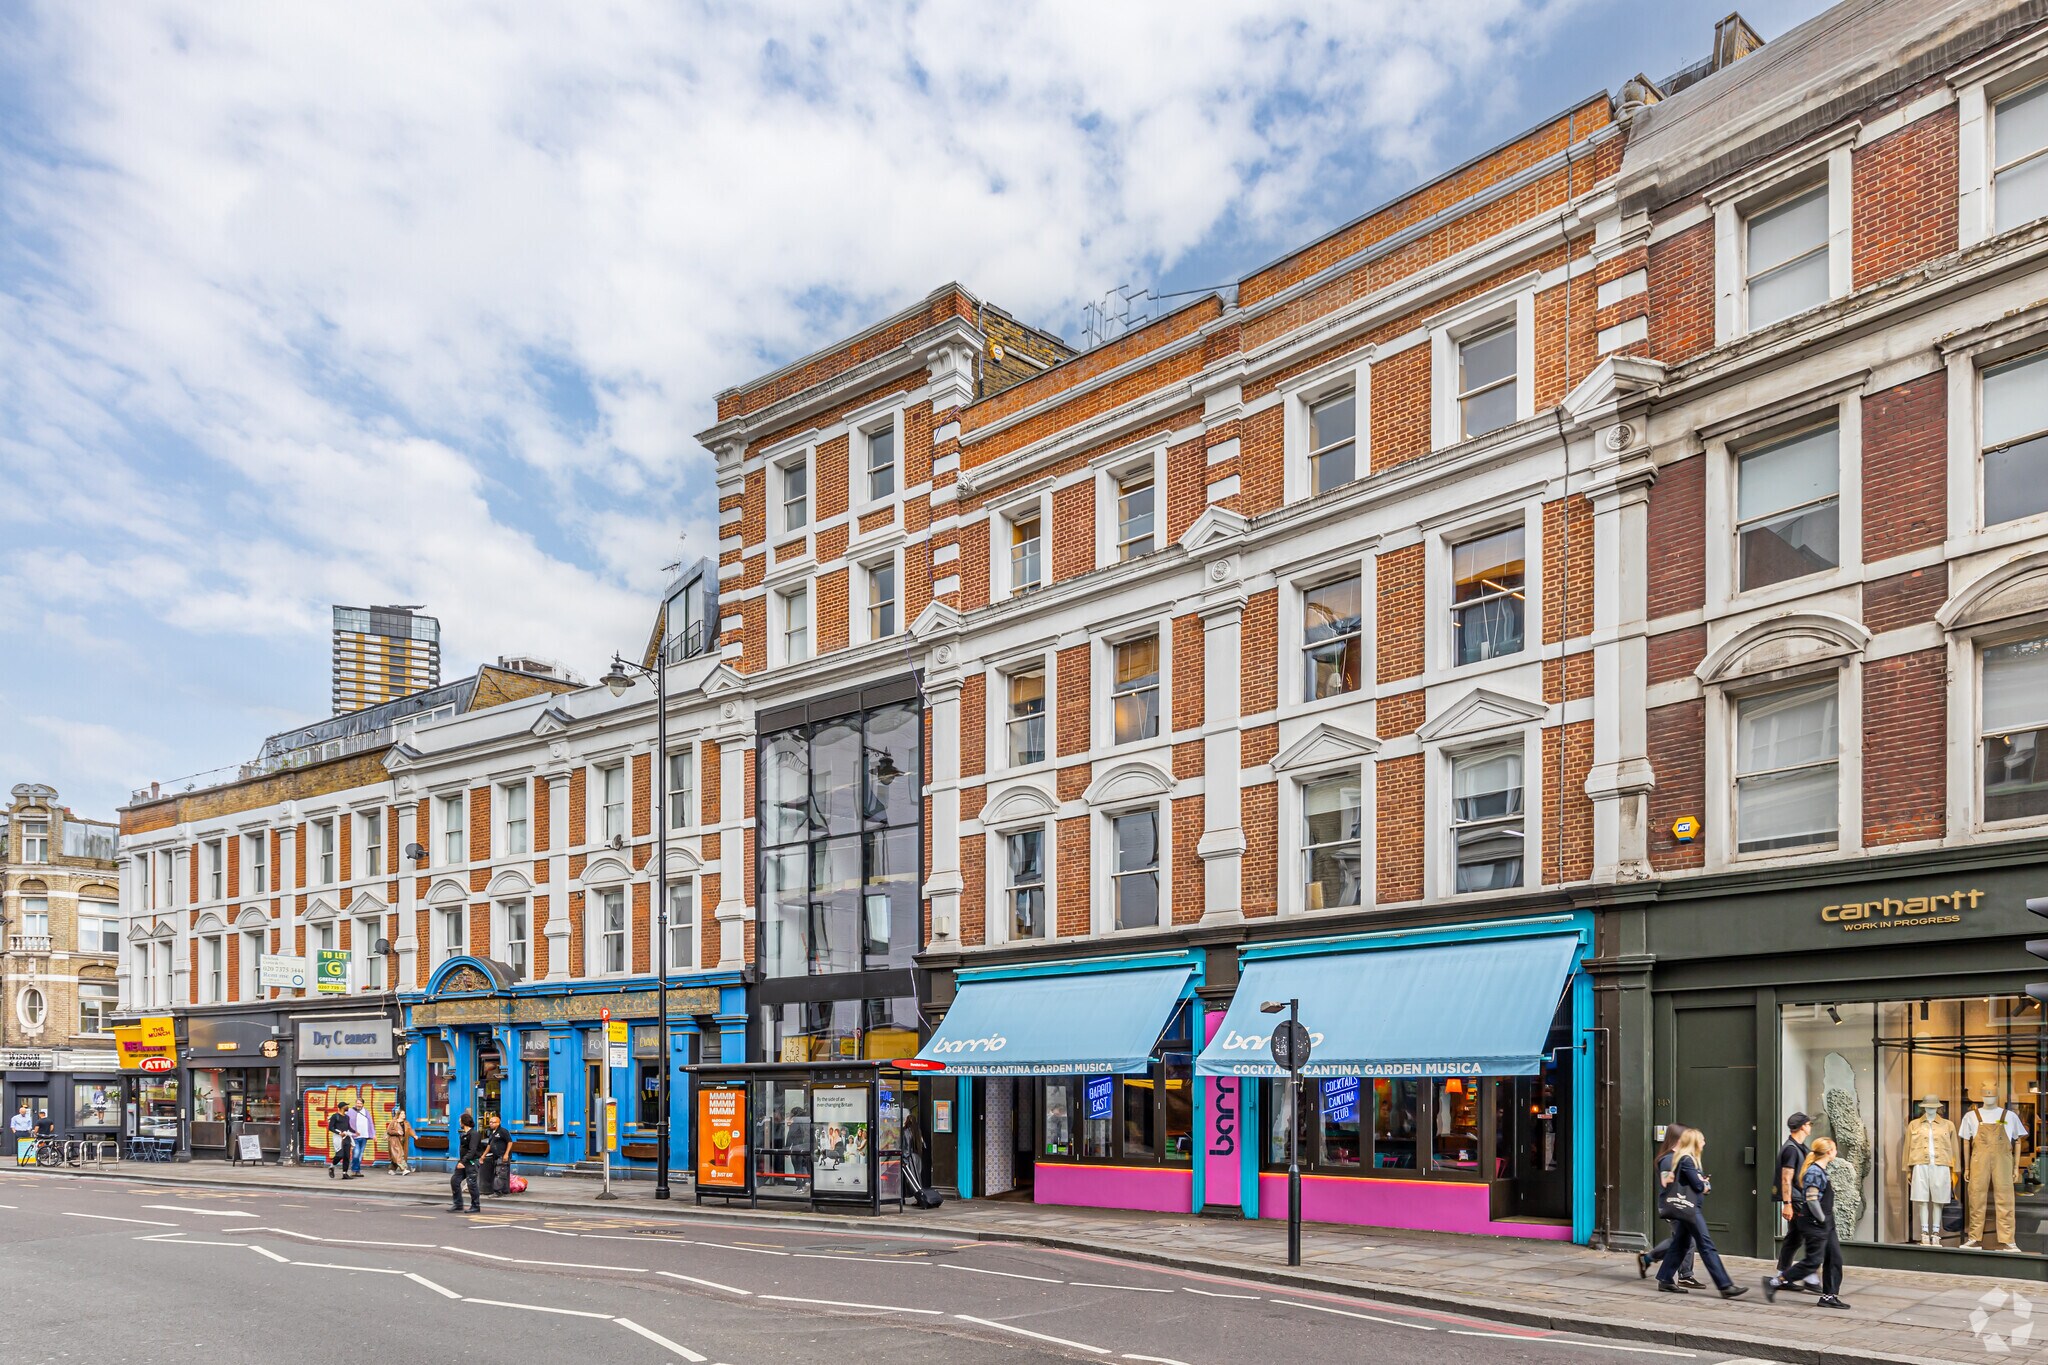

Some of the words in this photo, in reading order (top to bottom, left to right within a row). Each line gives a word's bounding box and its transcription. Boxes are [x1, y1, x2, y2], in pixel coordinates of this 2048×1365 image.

[1678, 823, 1691, 831] ADT
[1821, 888, 1985, 922] carhartt
[1843, 922, 1879, 932] WORK
[1879, 920, 1892, 929] IN
[1893, 914, 1962, 927] PROGRESS
[323, 951, 333, 960] TO
[334, 951, 347, 961] LET
[327, 961, 342, 976] G
[602, 1009, 609, 1019] P
[313, 1031, 332, 1049] Dry
[525, 1040, 549, 1050] MUSIC
[933, 1033, 1007, 1054] barrio
[1222, 1027, 1325, 1051] baro
[785, 1046, 800, 1055] 143
[145, 1060, 172, 1070] ATM
[989, 1065, 1031, 1074] CANTINA
[1033, 1063, 1073, 1074] GARDEN
[1075, 1062, 1114, 1073] MUSICA
[1233, 1064, 1300, 1076] COCKTA
[1303, 1063, 1361, 1076] CANTINA
[1364, 1063, 1422, 1075] GARDEN
[1425, 1062, 1482, 1075] MUSICA
[1089, 1082, 1112, 1100] BARRIO
[1325, 1077, 1359, 1094] COCKTAILS
[709, 1092, 736, 1100] MMMM
[1328, 1091, 1355, 1108] CANTINA
[709, 1100, 736, 1108] MMMM
[709, 1107, 736, 1115] MMMM
[1093, 1097, 1108, 1112] EAST
[1333, 1107, 1349, 1122] CLUB
